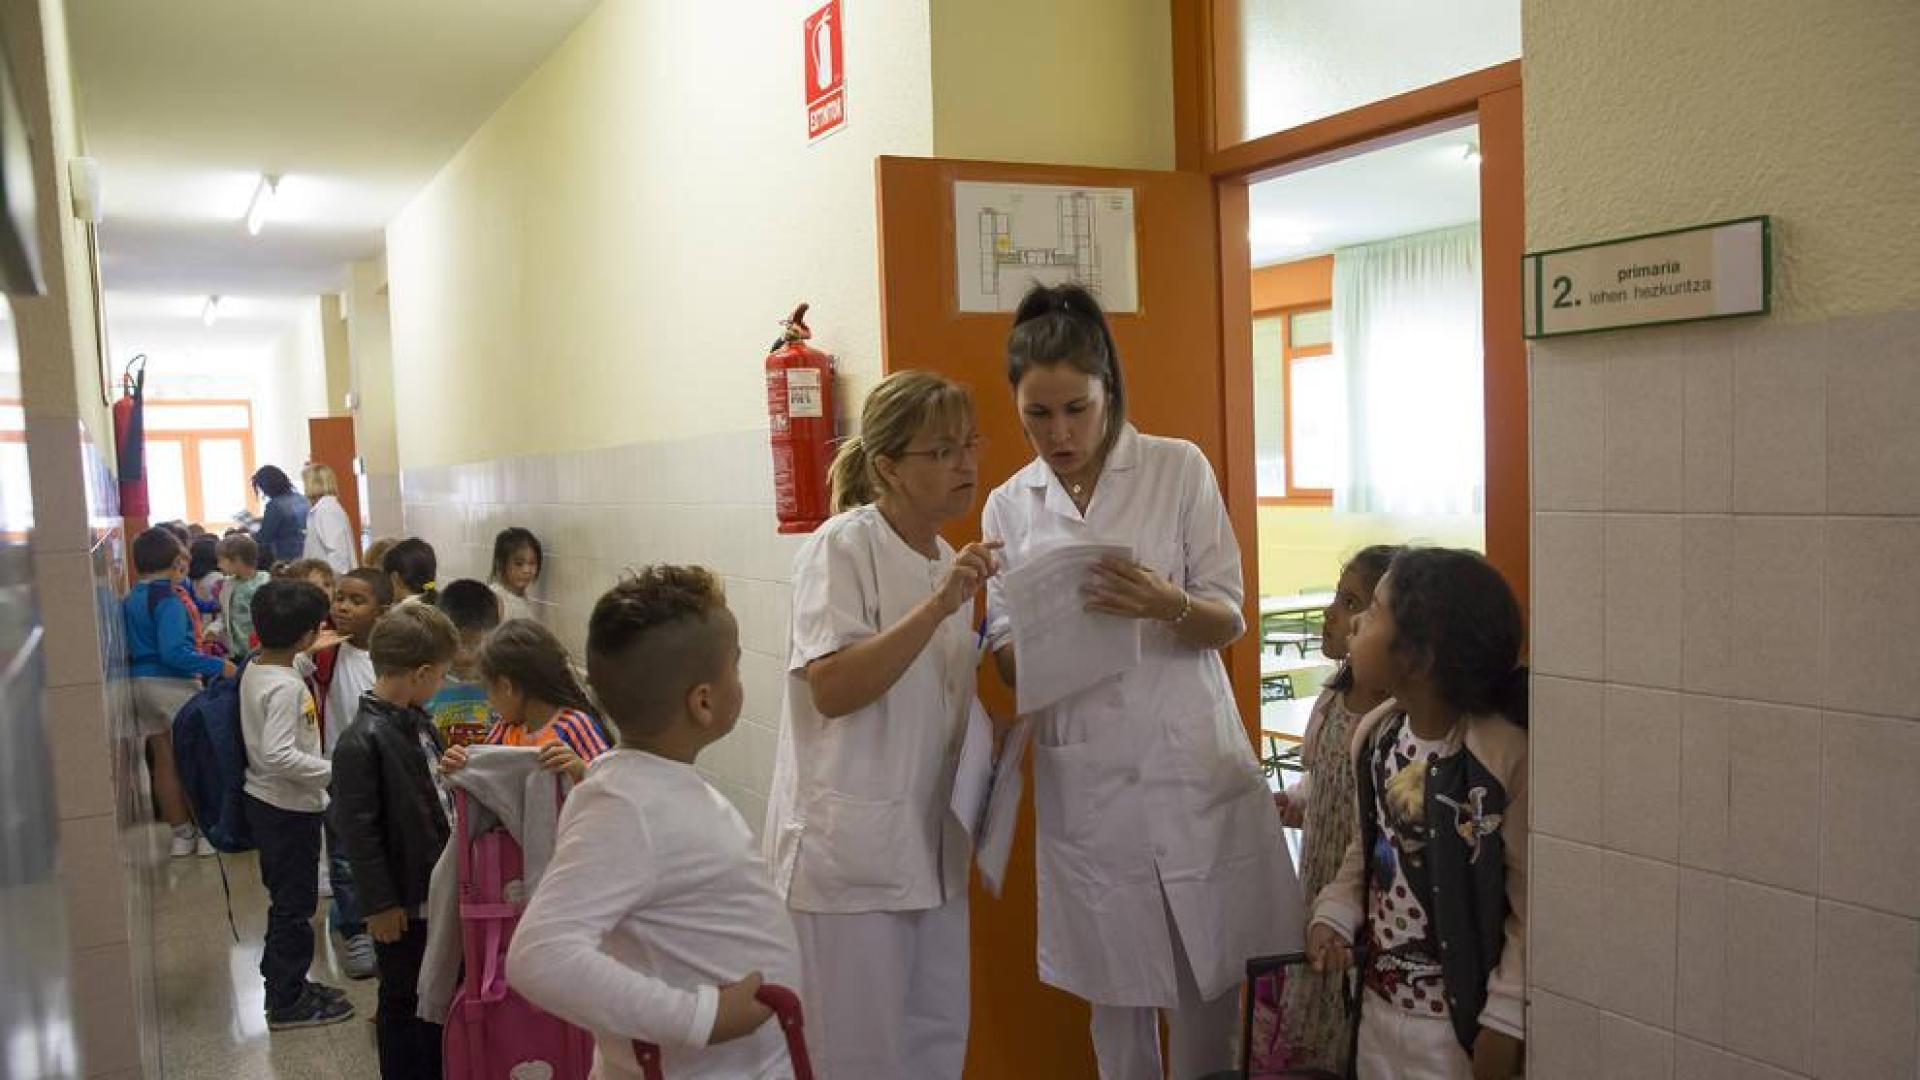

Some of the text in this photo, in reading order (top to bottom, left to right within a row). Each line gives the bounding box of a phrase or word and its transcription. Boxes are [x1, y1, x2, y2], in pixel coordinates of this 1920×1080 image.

[1617, 260, 1680, 283] primaria
[1552, 275, 1712, 309] 2. lehen hezkuntza
